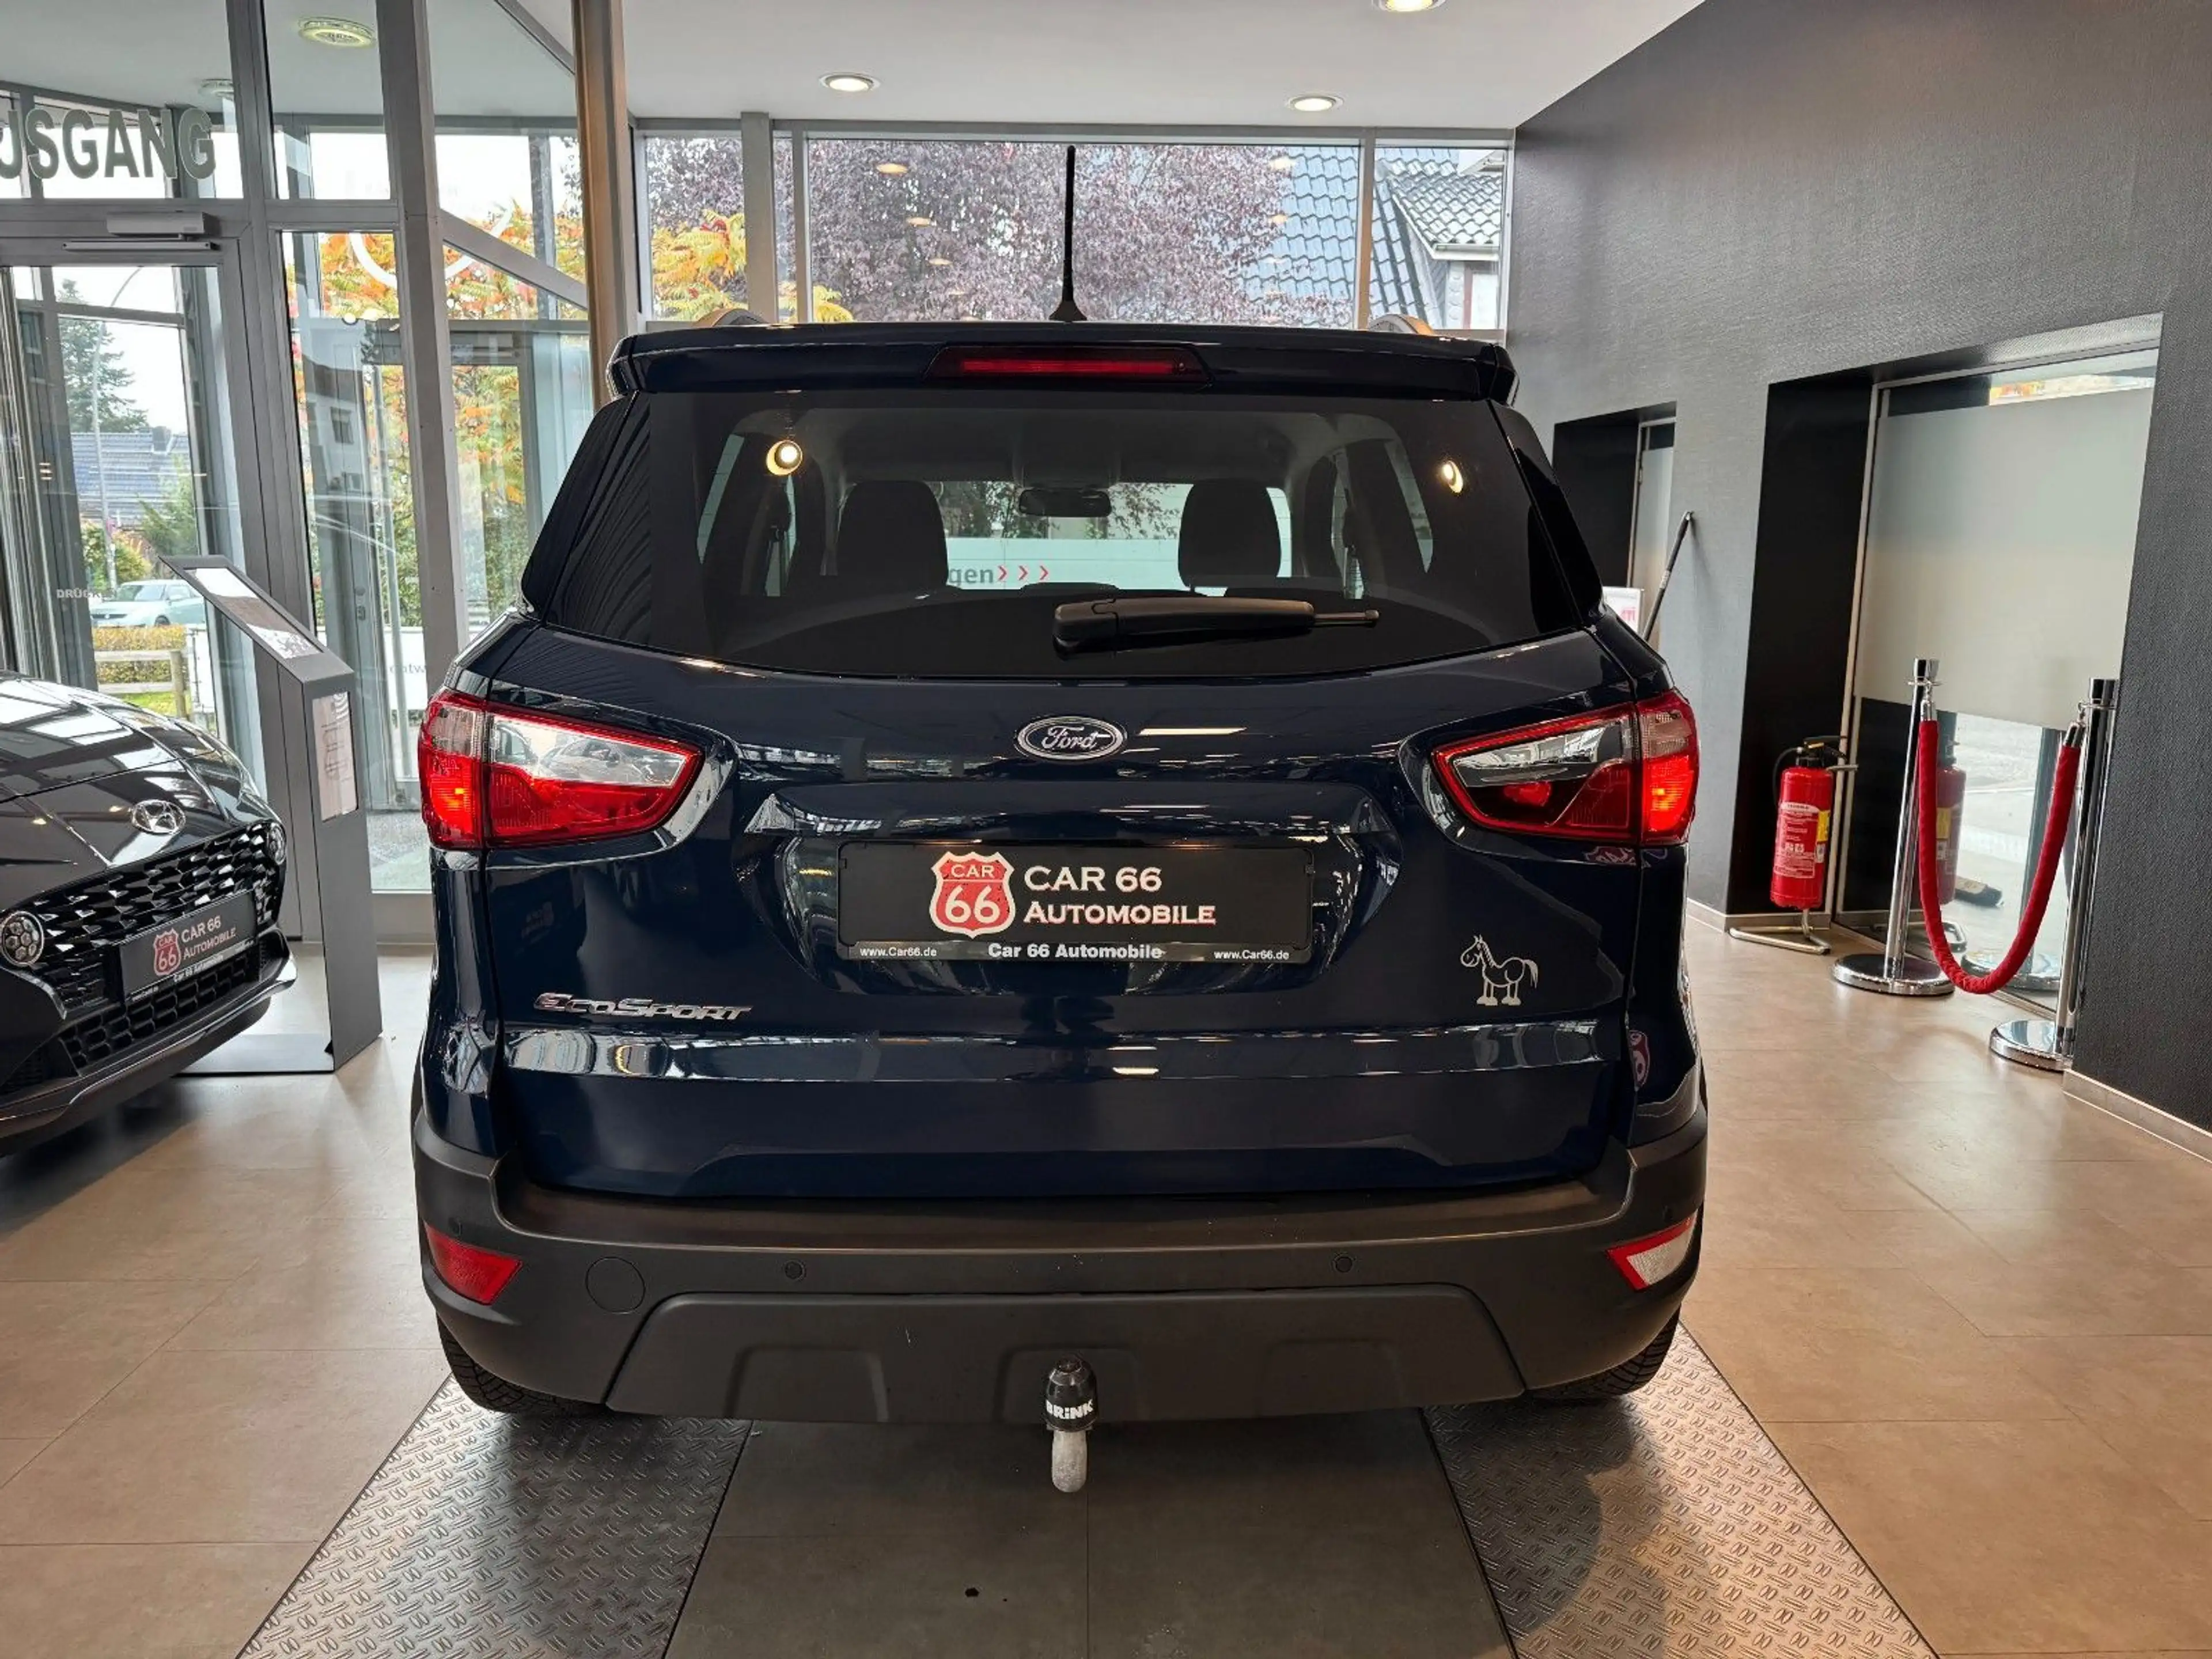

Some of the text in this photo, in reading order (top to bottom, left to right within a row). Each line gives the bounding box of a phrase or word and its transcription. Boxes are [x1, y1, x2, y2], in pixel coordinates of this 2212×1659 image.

[1041, 726, 1111, 749] Ford
[951, 864, 995, 878] CAR
[1024, 865, 1162, 893] CAR 66
[945, 885, 1000, 923] 66
[1023, 901, 1217, 925] AUTOMOBILE
[159, 935, 175, 946] CAR
[181, 915, 222, 943] CAR 66
[158, 949, 177, 971] 66
[860, 942, 1290, 960] www.Car66.de Car 66 Automobile www.Car66.de
